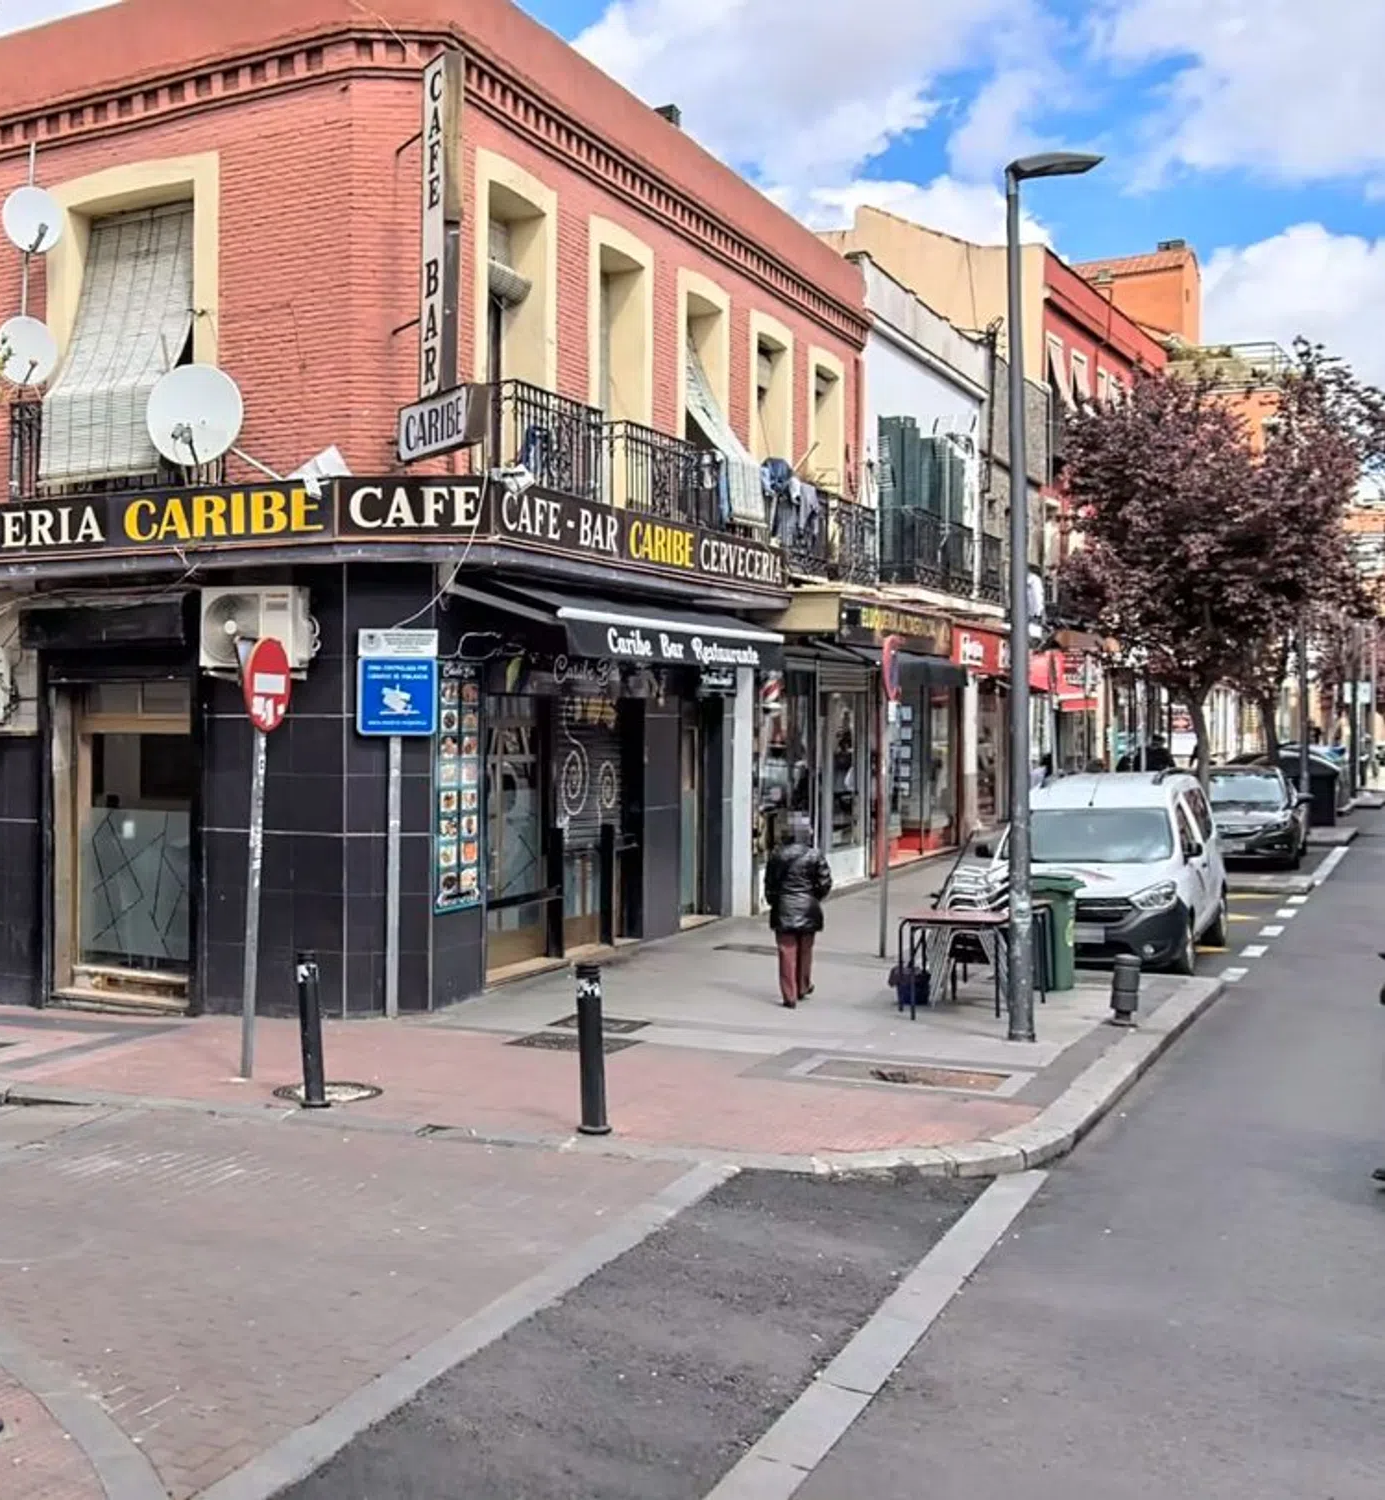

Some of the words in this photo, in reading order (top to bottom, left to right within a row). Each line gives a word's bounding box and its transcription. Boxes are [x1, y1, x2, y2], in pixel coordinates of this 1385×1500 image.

[427, 71, 443, 211] CAFE
[423, 259, 439, 387] BAR
[404, 396, 463, 456] CARIBE
[123, 488, 324, 542] CARIBE
[349, 486, 482, 529] CAFE
[501, 491, 562, 541] CAFE
[579, 507, 619, 552] BAR
[628, 519, 695, 569] CARIBE
[700, 537, 784, 586] CERVECERIA
[607, 627, 653, 658] Caribe
[659, 633, 685, 660] Bar
